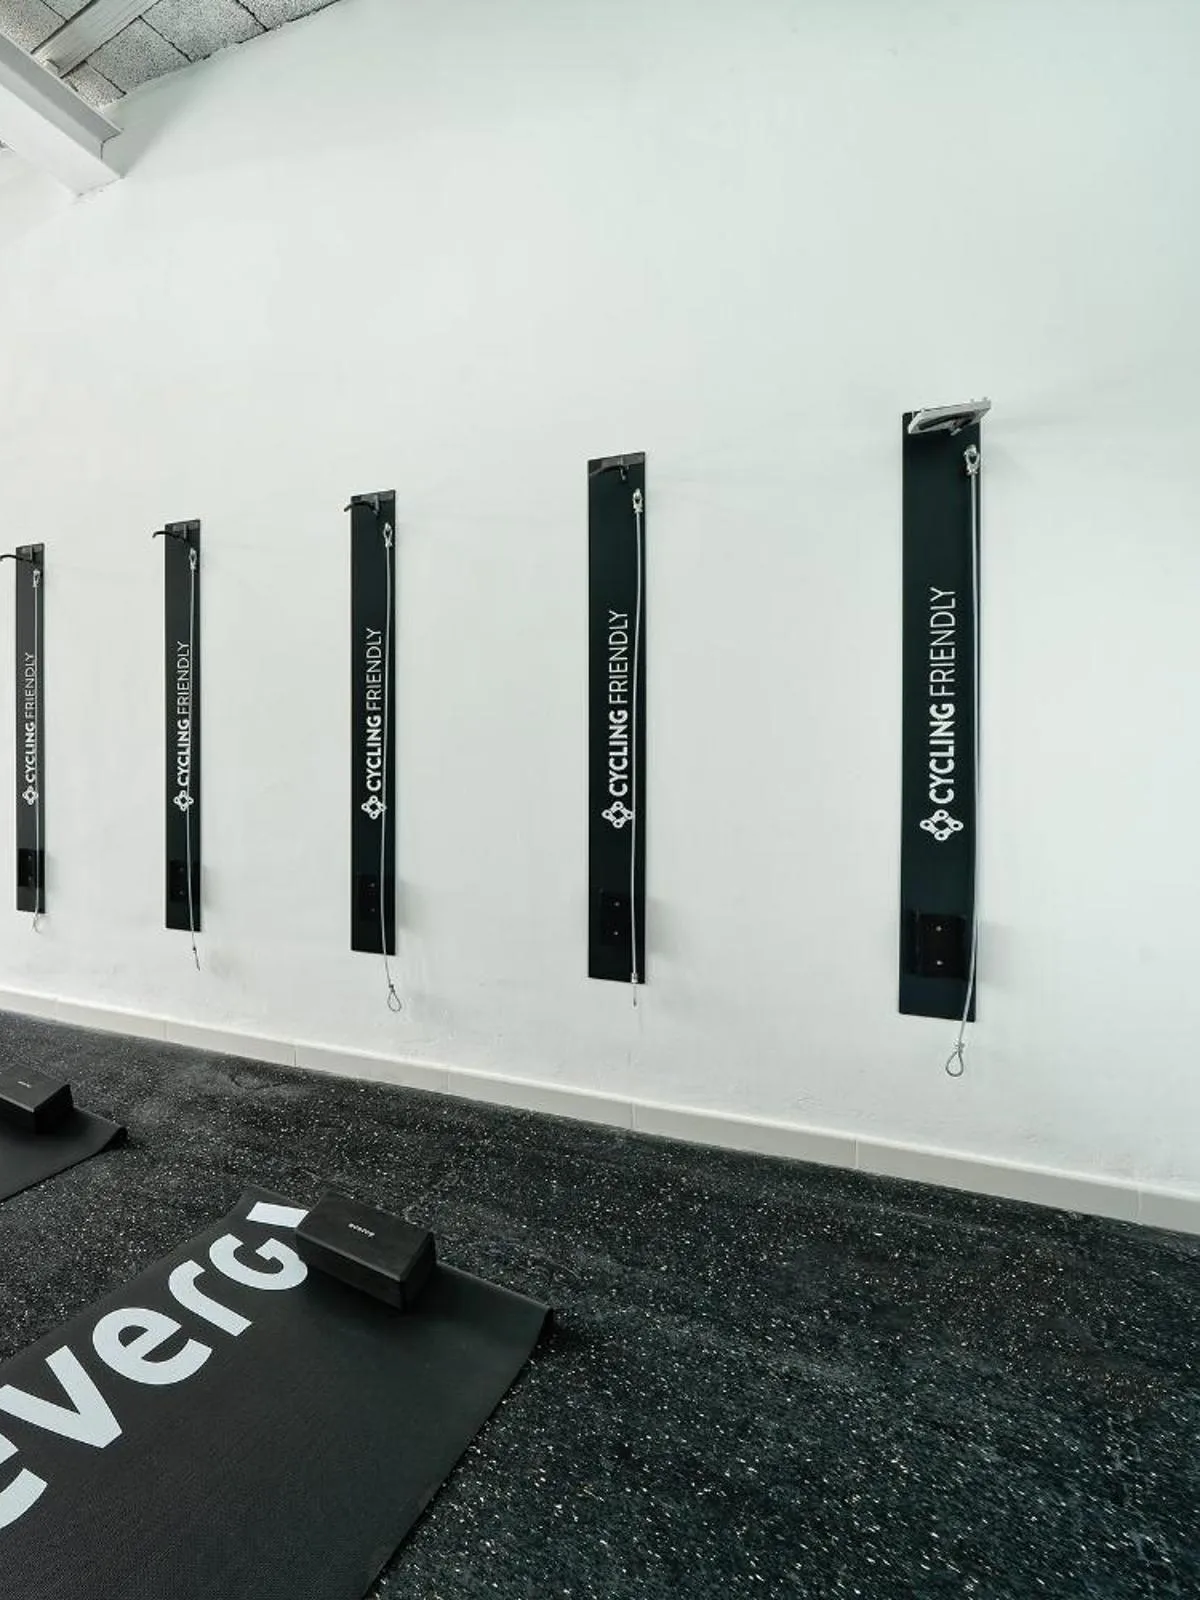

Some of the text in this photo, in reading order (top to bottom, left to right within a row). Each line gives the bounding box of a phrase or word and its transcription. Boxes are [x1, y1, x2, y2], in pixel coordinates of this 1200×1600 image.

[25, 652, 36, 783] CYCLING FRIENDLY
[177, 641, 190, 786] CYCLING FRIENDLY
[366, 628, 381, 791] CYCLING FRIENDLY
[608, 610, 628, 797] CYCLING FRIENDLY
[929, 586, 956, 804] CYCLING FRIENDLY
